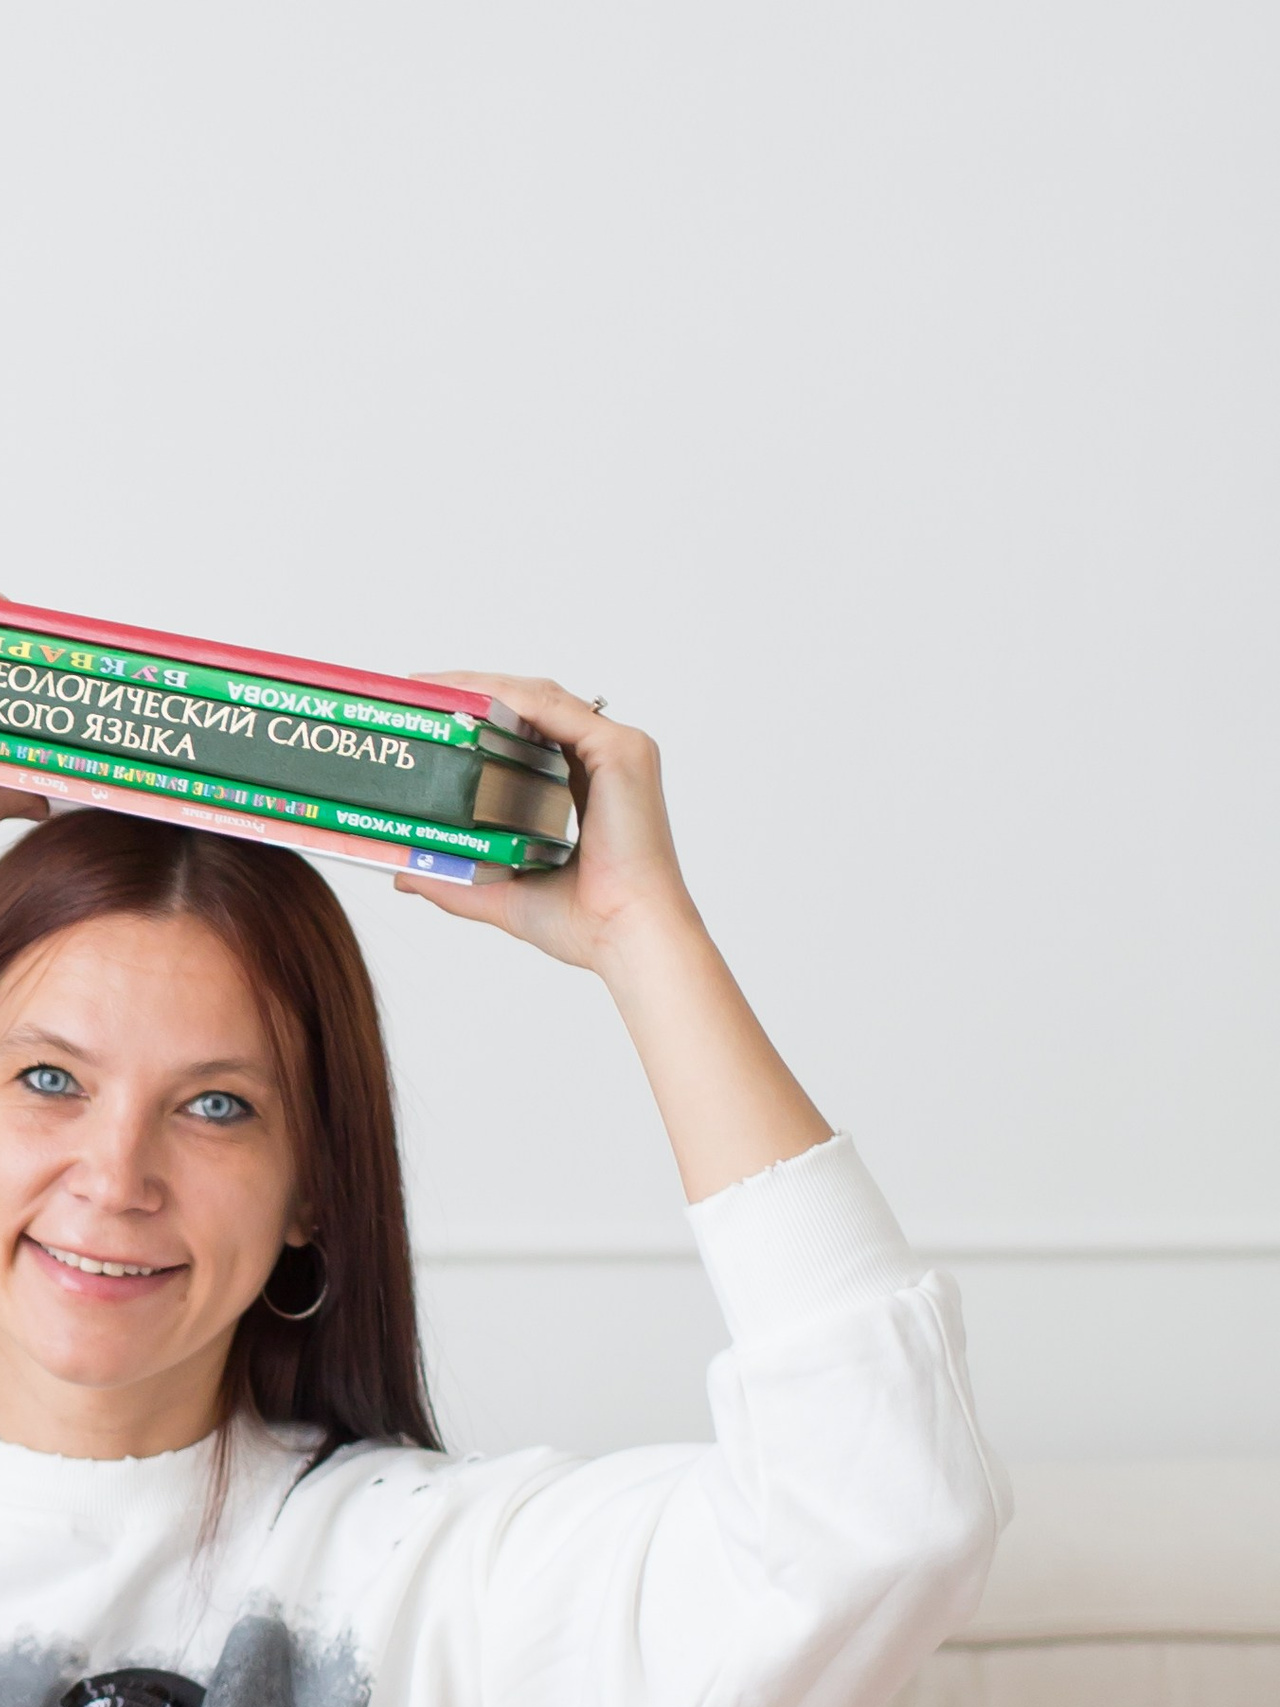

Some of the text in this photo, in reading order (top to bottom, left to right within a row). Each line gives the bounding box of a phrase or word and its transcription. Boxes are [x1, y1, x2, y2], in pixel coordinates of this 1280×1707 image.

[227, 680, 451, 741] Надежда ЖУКОВА
[80, 713, 197, 761] ЯЗЫКА
[267, 715, 416, 770] СЛОВАРЬ
[15, 745, 53, 765] ДЛЯ
[56, 753, 110, 777] КНИГА
[18, 772, 29, 784] 2
[32, 775, 69, 793] Часть
[113, 764, 190, 793] БУКВАРЯ
[191, 781, 248, 806] ПОСЛЕ
[252, 793, 320, 819] ПЕРВАЯ
[214, 810, 267, 834] Русский
[336, 809, 491, 854] Надежда ЖУКОВА
